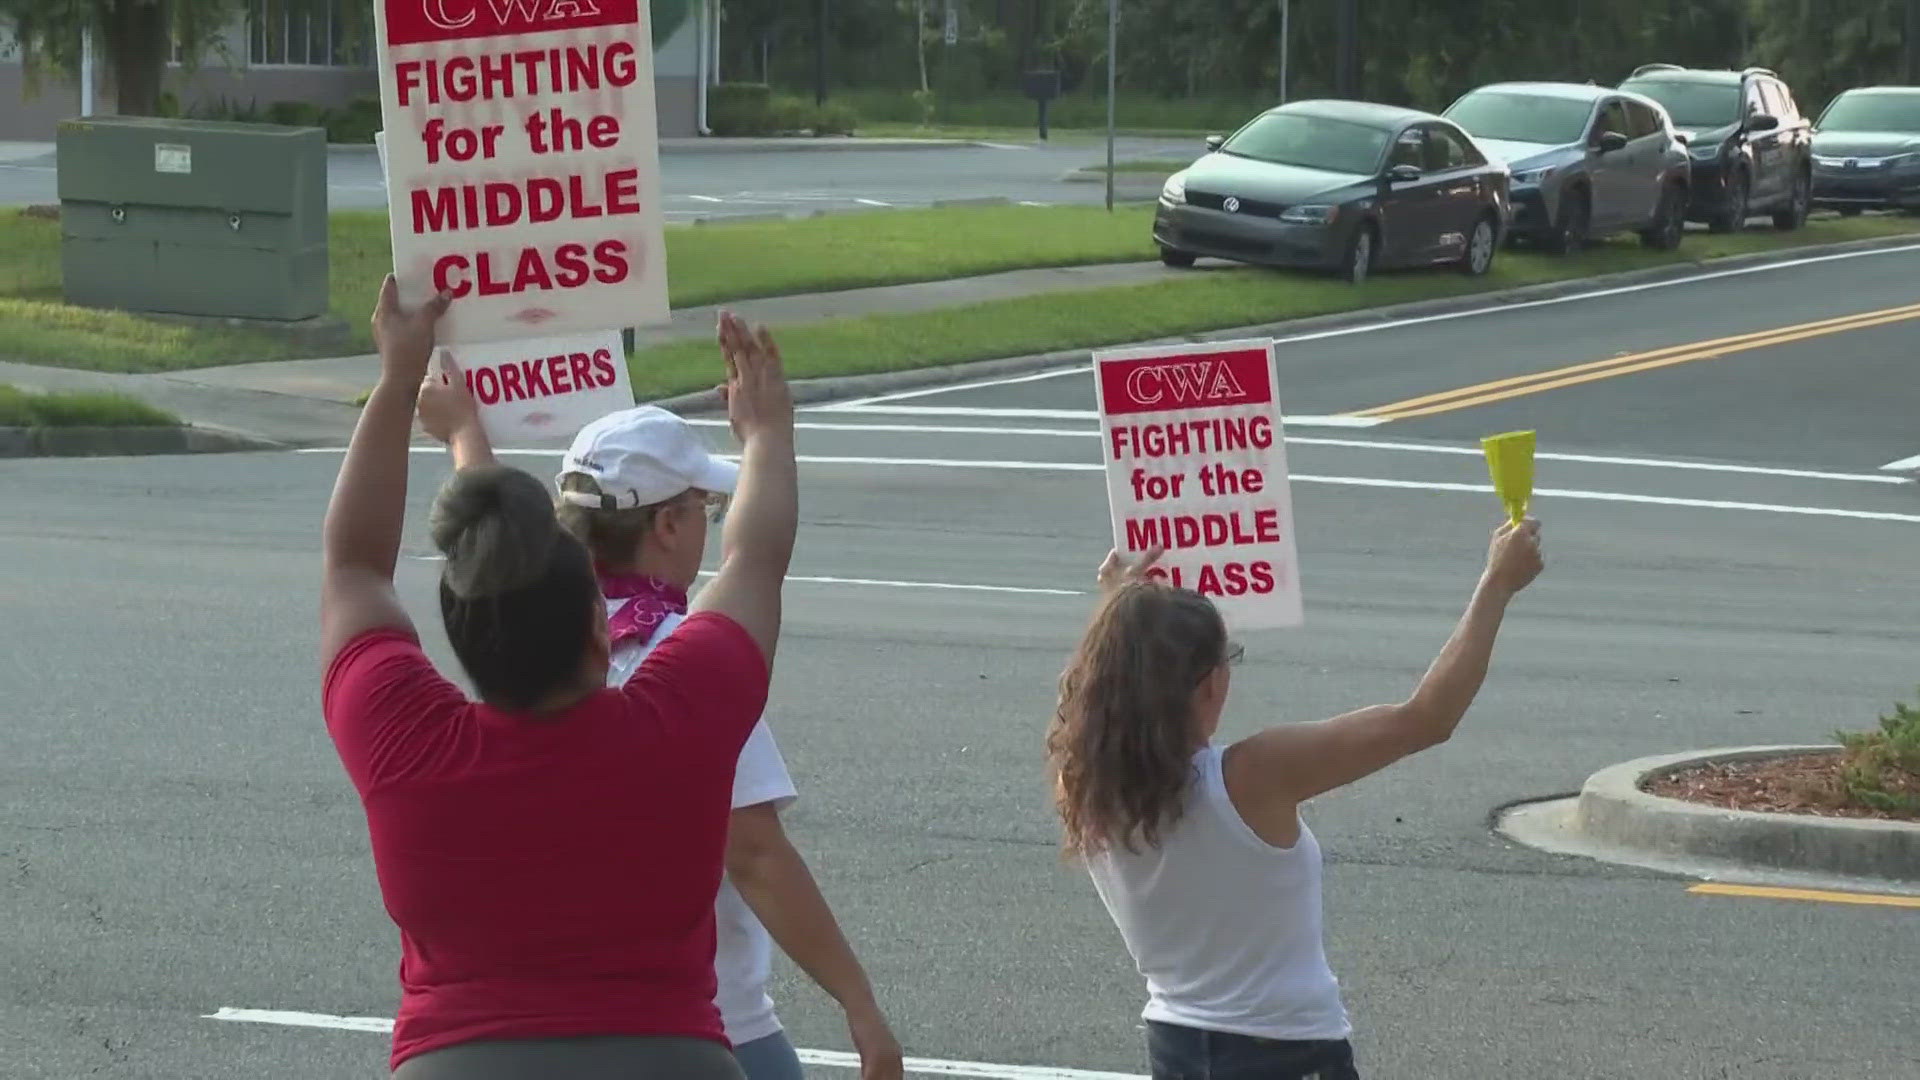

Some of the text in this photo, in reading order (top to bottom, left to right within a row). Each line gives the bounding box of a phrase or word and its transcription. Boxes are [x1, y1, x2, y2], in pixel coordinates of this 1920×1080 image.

[395, 41, 638, 107] FIGHTING
[422, 107, 621, 164] for the
[411, 168, 641, 234] MIDDLE
[433, 239, 630, 299] CLASS
[1126, 359, 1247, 405] CWA
[1111, 415, 1273, 460] FIGHTING
[1131, 463, 1264, 502] for the
[1126, 509, 1280, 552] MIDDLE
